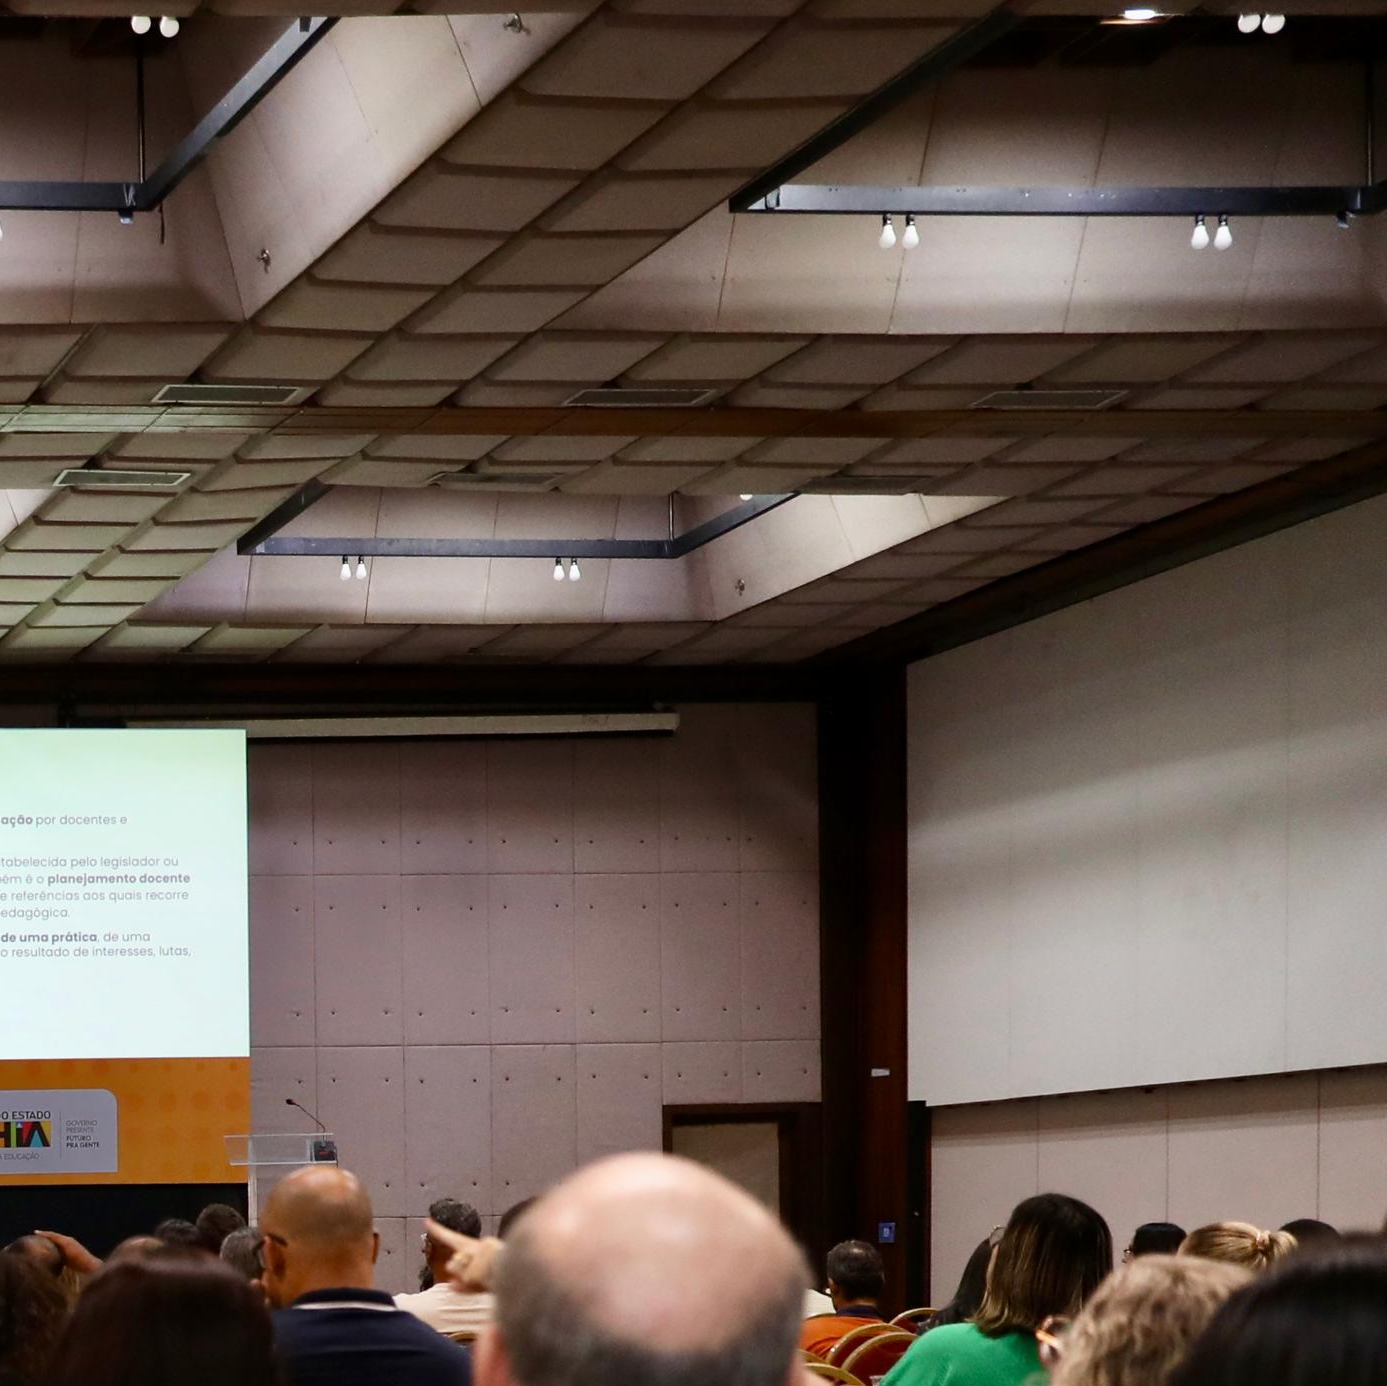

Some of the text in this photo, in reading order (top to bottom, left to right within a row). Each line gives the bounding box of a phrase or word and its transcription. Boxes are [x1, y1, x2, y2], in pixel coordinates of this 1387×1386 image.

[1, 815, 33, 828] ação
[36, 817, 56, 828] por
[59, 815, 116, 825] docentes
[71, 856, 97, 870] pelo
[100, 856, 160, 870] legislador
[163, 858, 178, 866] ou
[25, 874, 33, 884] é
[36, 876, 44, 884] o
[48, 873, 136, 887] planejamento
[139, 874, 190, 883] docente
[0, 893, 7, 901] e
[11, 891, 80, 901] referências
[83, 892, 105, 900] aos
[109, 892, 142, 903] quais
[146, 892, 189, 900] recorre
[1, 933, 16, 942] de
[20, 934, 48, 942] uma
[103, 932, 119, 942] de
[122, 934, 150, 942] uma
[12, 947, 70, 957] resultado
[73, 947, 89, 957] de
[12, 1111, 51, 1120] ESTADO
